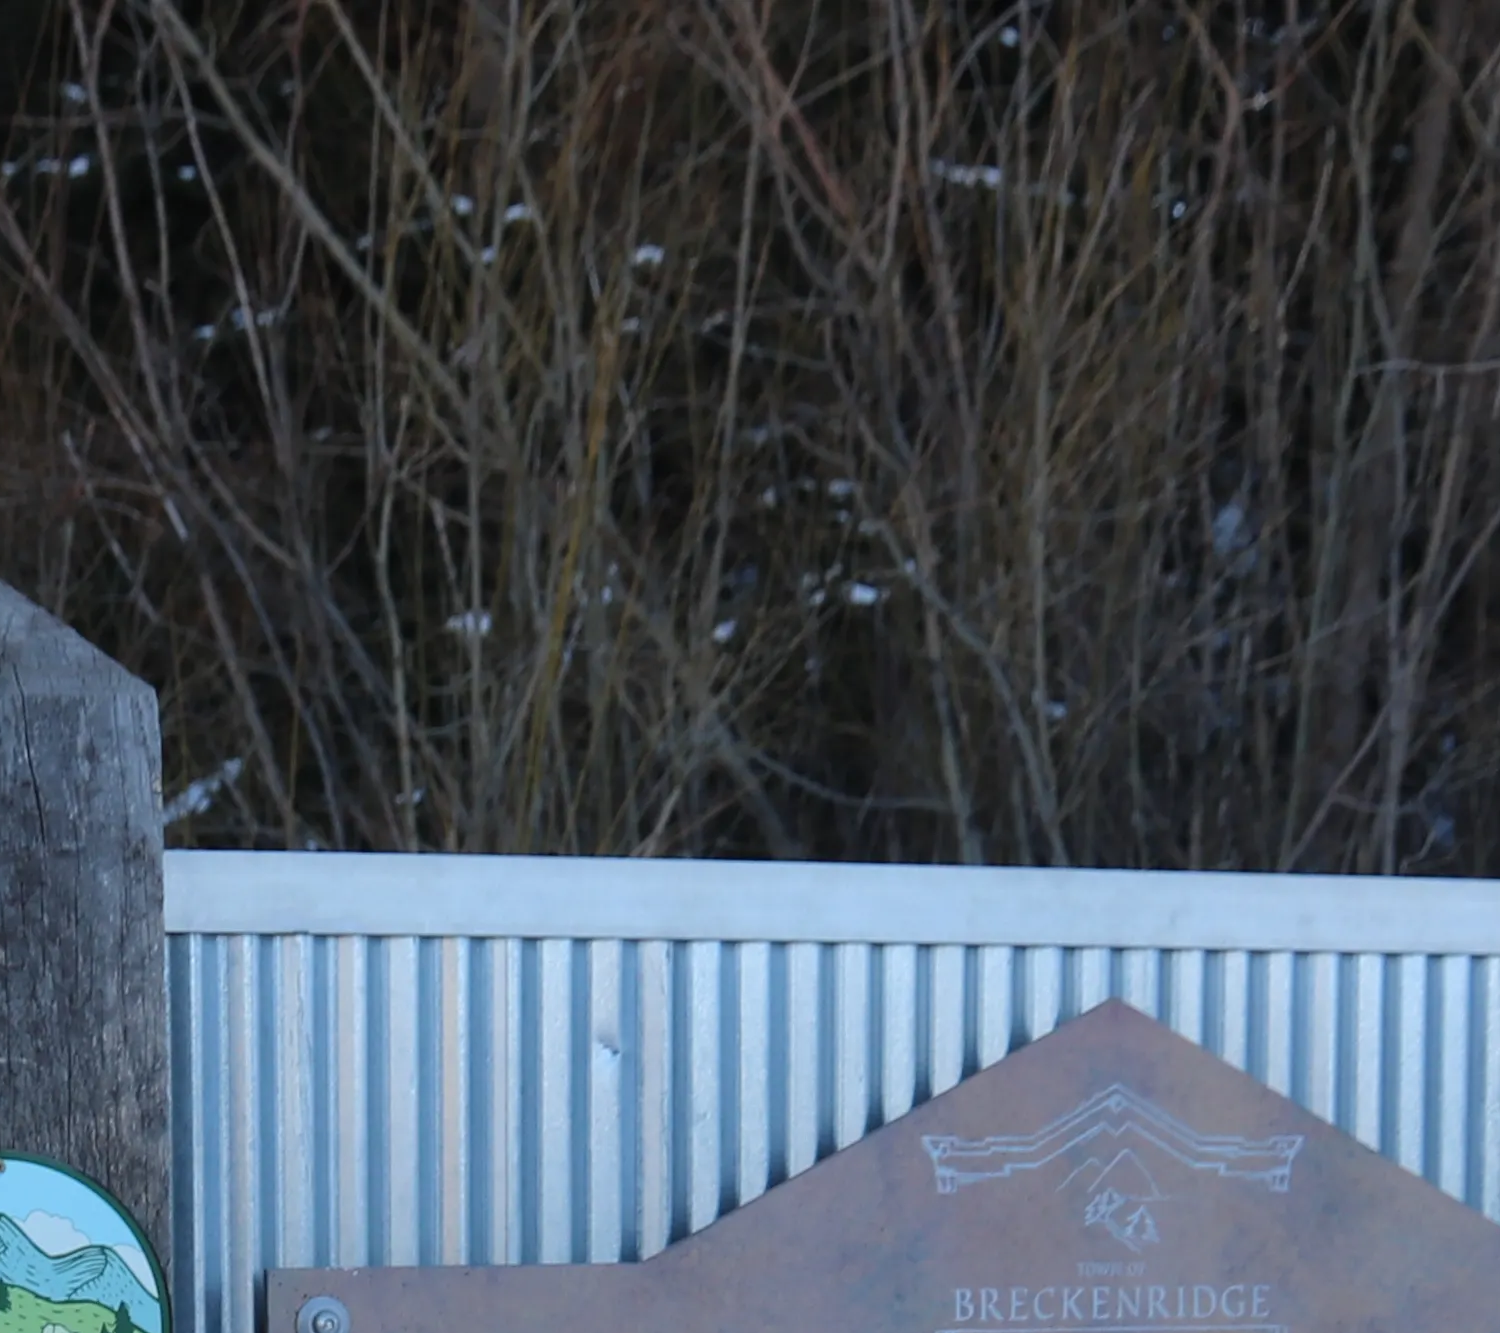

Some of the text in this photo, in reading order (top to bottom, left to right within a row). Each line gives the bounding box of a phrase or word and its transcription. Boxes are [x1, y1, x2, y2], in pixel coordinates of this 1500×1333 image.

[1077, 1261, 1147, 1277] TOWN OF
[954, 1285, 1270, 1322] BRECKENRIDGE
